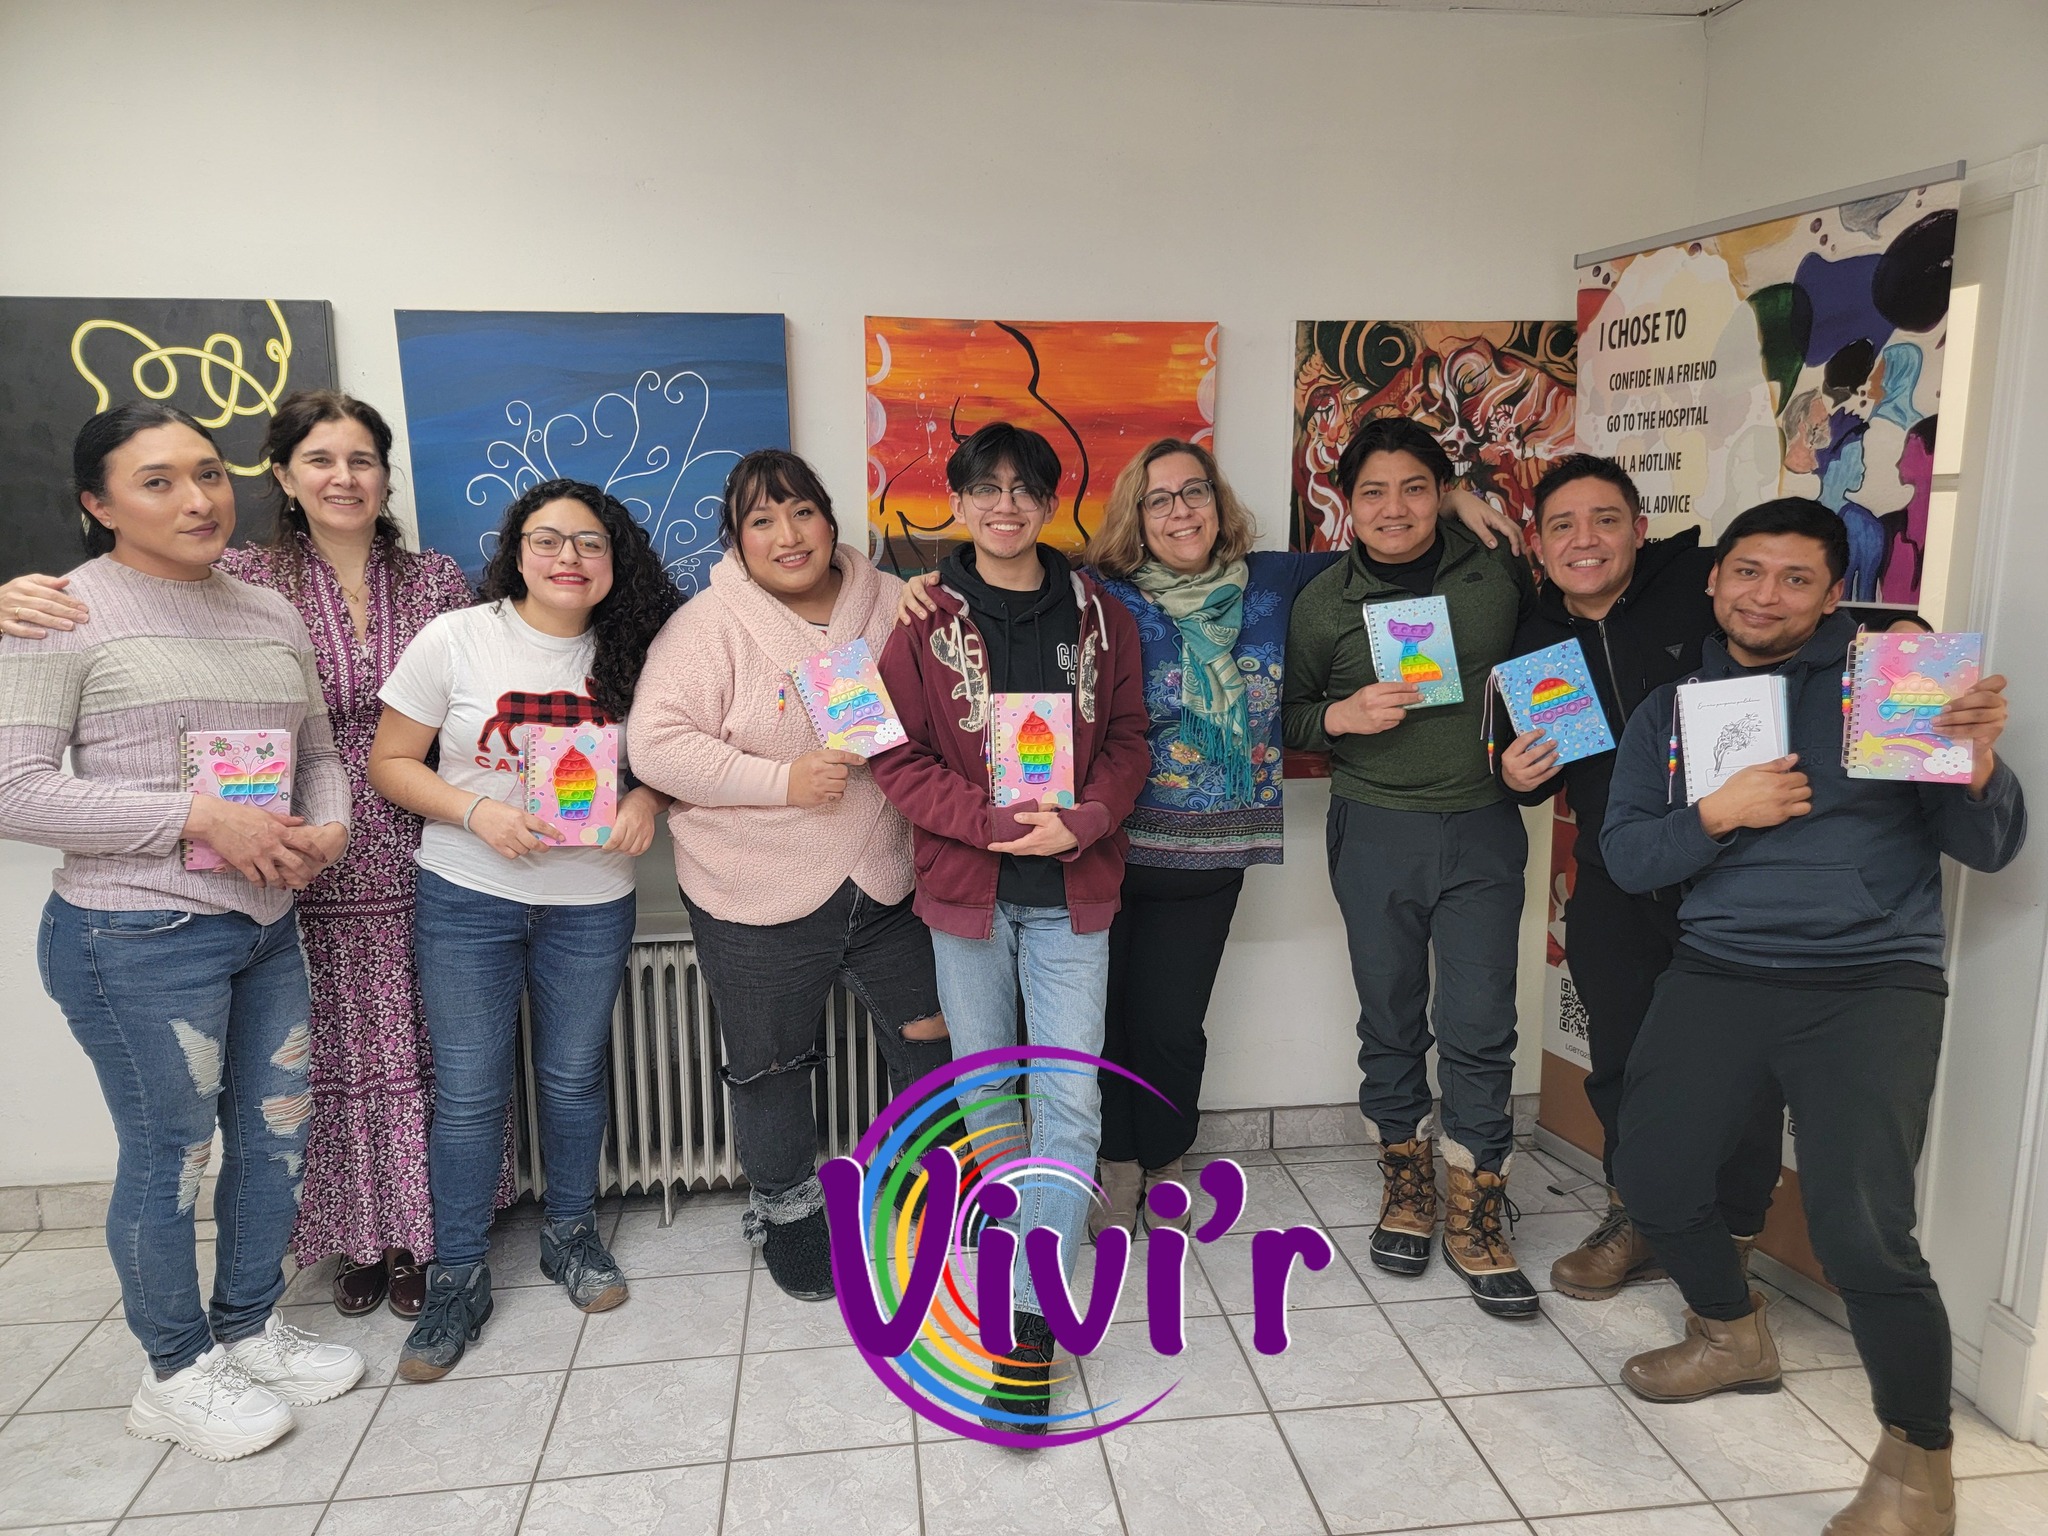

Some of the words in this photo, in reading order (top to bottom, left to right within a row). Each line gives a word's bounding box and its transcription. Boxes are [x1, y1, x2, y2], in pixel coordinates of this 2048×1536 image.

[1599, 322, 1605, 352] I
[1608, 312, 1661, 350] CHOSE
[1665, 307, 1687, 341] TO
[1609, 368, 1652, 391] CONFIDE
[1653, 366, 1665, 386] IN
[1666, 365, 1674, 385] A
[1676, 359, 1717, 383] FRIEND
[1606, 414, 1621, 433] GO
[1623, 413, 1635, 431] TO
[1637, 411, 1656, 431] THE
[1658, 405, 1709, 429] HOSPITAL
[1629, 454, 1636, 473] A
[1638, 451, 1682, 473] HOTLINE
[1653, 494, 1691, 514] ADVICE
